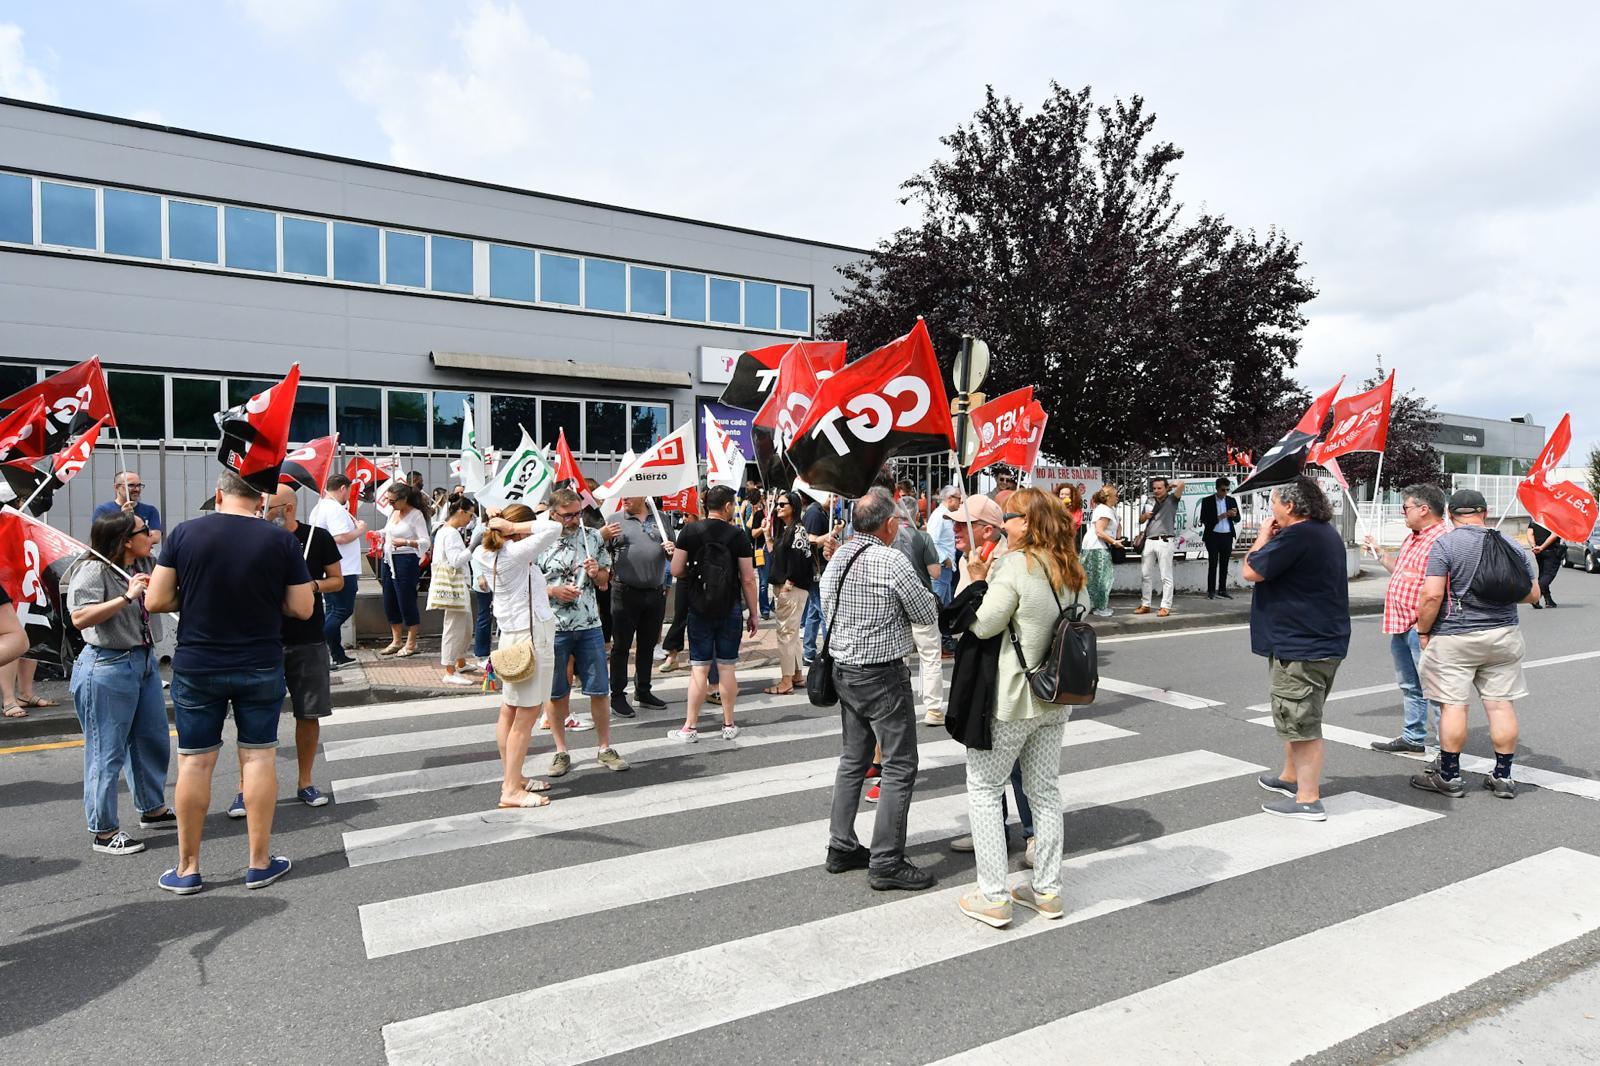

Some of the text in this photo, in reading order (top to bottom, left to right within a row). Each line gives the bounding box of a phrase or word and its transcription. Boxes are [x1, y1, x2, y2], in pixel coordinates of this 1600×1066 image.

[730, 418, 747, 426] cada
[635, 472, 668, 482] Bierzo
[1036, 468, 1098, 480] NO AL ERE SALVAJE
[1185, 539, 1206, 549] Teleper
